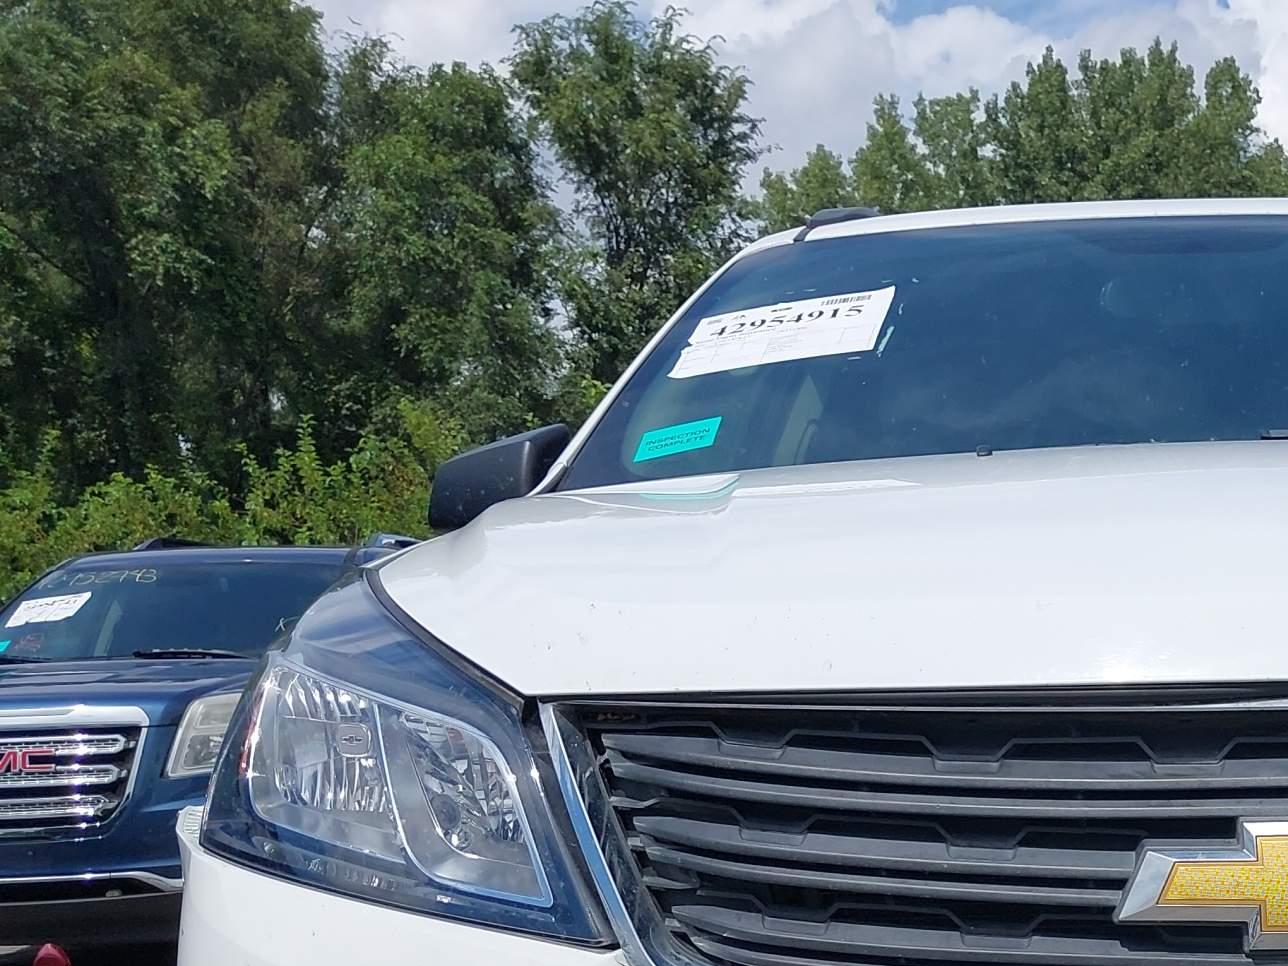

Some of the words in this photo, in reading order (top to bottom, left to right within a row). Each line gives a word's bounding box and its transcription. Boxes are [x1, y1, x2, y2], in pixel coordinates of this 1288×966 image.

[710, 304, 865, 337] 42954915
[645, 427, 711, 446] INSPECTION
[648, 435, 705, 452] COMPLETE
